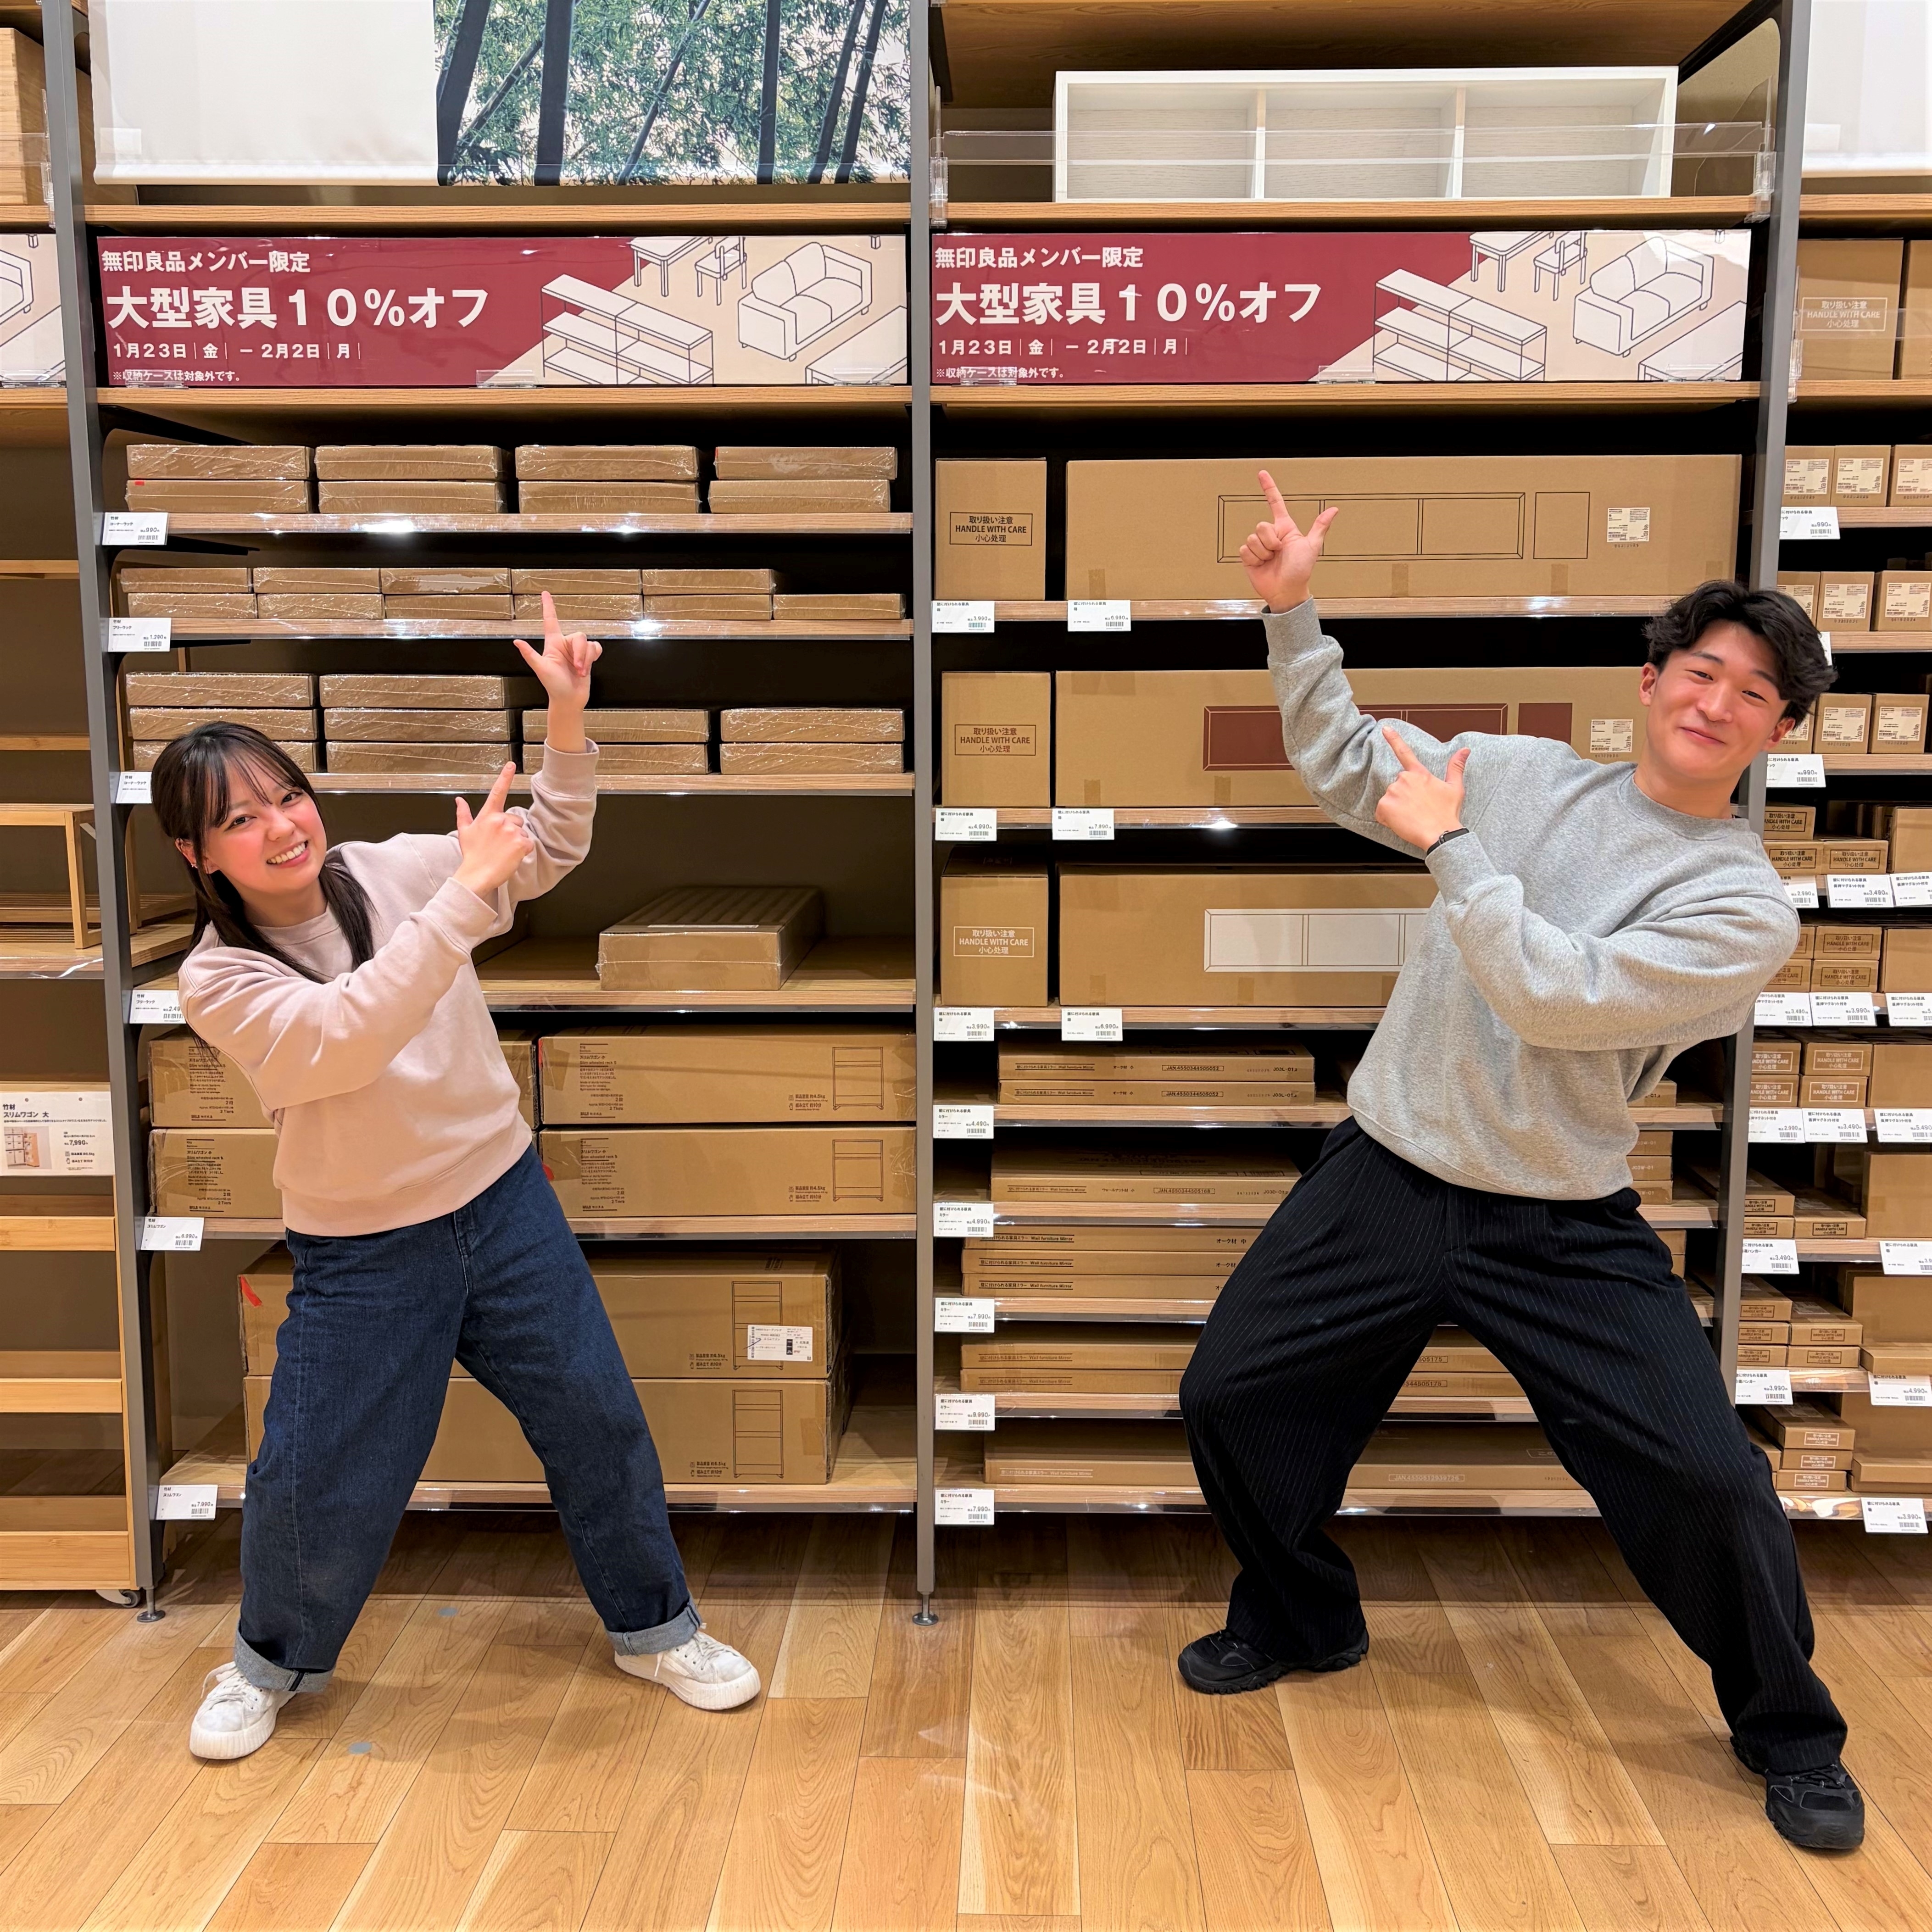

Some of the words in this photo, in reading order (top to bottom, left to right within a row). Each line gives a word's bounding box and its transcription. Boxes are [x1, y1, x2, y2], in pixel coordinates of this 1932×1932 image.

[935, 247, 1143, 268] 無印良品メンバー限定
[102, 251, 311, 273] 無印良品メンバー限定
[1822, 301, 1867, 309] 取り扱い注意
[1860, 311, 1880, 319] CARE
[1826, 320, 1859, 328] 小心处理
[969, 515, 1013, 524] 取り扱い注意
[972, 930, 1015, 938] 取り扱い注意
